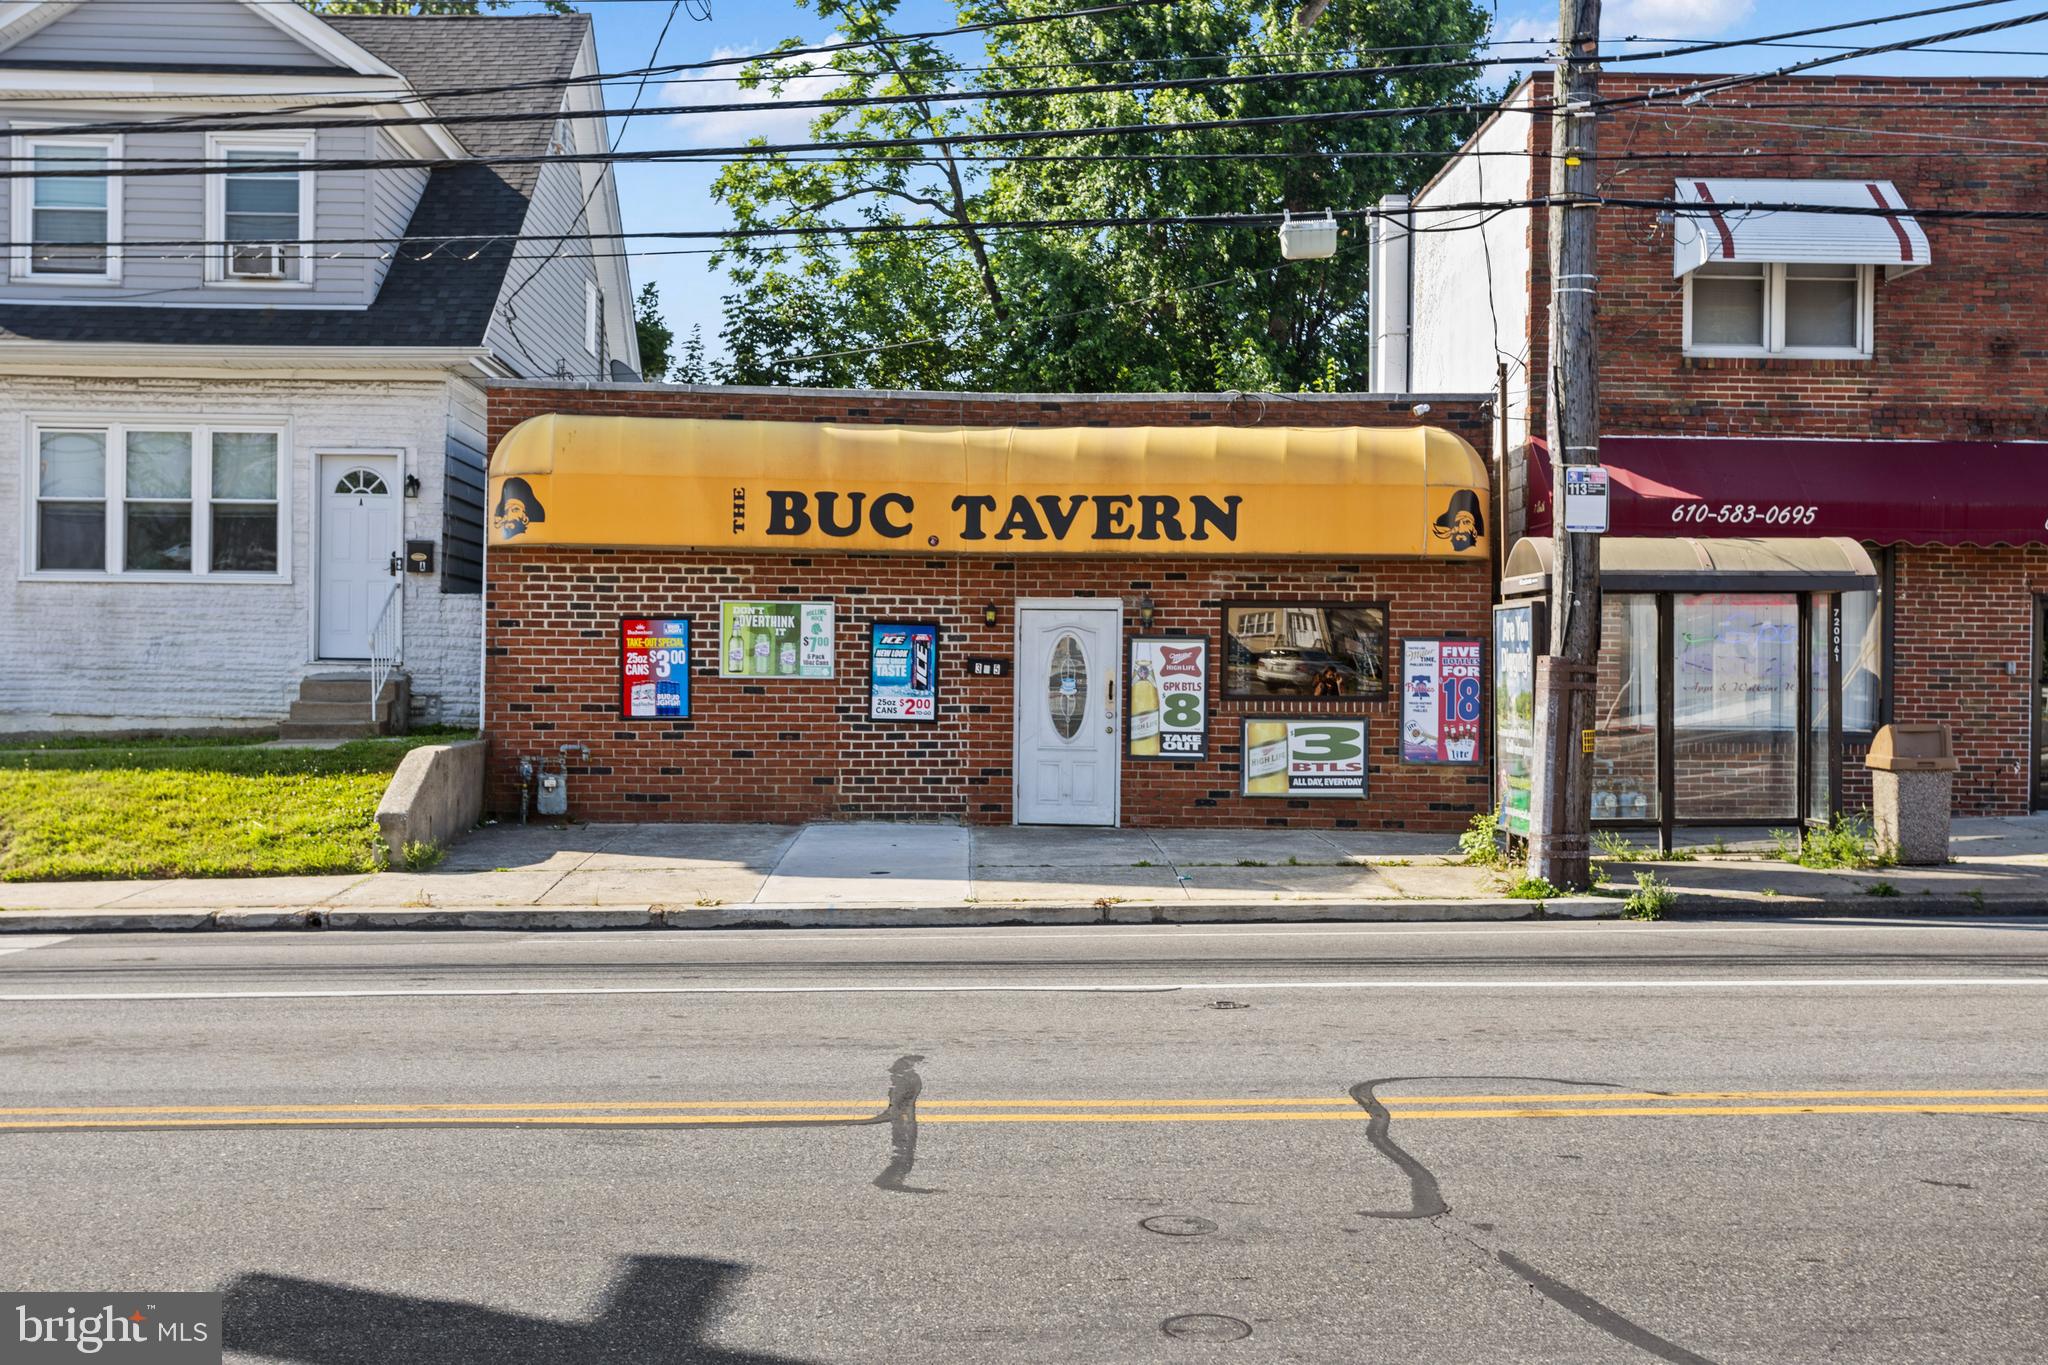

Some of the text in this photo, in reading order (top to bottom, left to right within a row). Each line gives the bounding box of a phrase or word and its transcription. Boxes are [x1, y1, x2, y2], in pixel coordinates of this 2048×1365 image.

[1568, 483, 1588, 495] 113
[733, 487, 745, 534] THE
[1671, 503, 1818, 525] 610-583-0695
[951, 494, 1243, 541] TAVERN
[732, 606, 765, 615] DON'T
[775, 628, 787, 636] IT
[1502, 615, 1529, 641] Are You
[881, 636, 906, 644] ICE
[1442, 646, 1480, 657] FIVE
[626, 652, 648, 664] 25oz
[1442, 657, 1480, 665] BOTTLES
[625, 664, 650, 676] CANS
[916, 643, 928, 686] ICE
[876, 664, 907, 677] TASTE
[1442, 666, 1480, 677] FOR
[1181, 682, 1202, 691] BTLS
[1163, 734, 1202, 742] TAKE
[1162, 742, 1202, 751] OUT
[1292, 762, 1362, 772] BTLS
[1293, 778, 1308, 786] ALL
[1324, 778, 1362, 786] EVERYDAY
